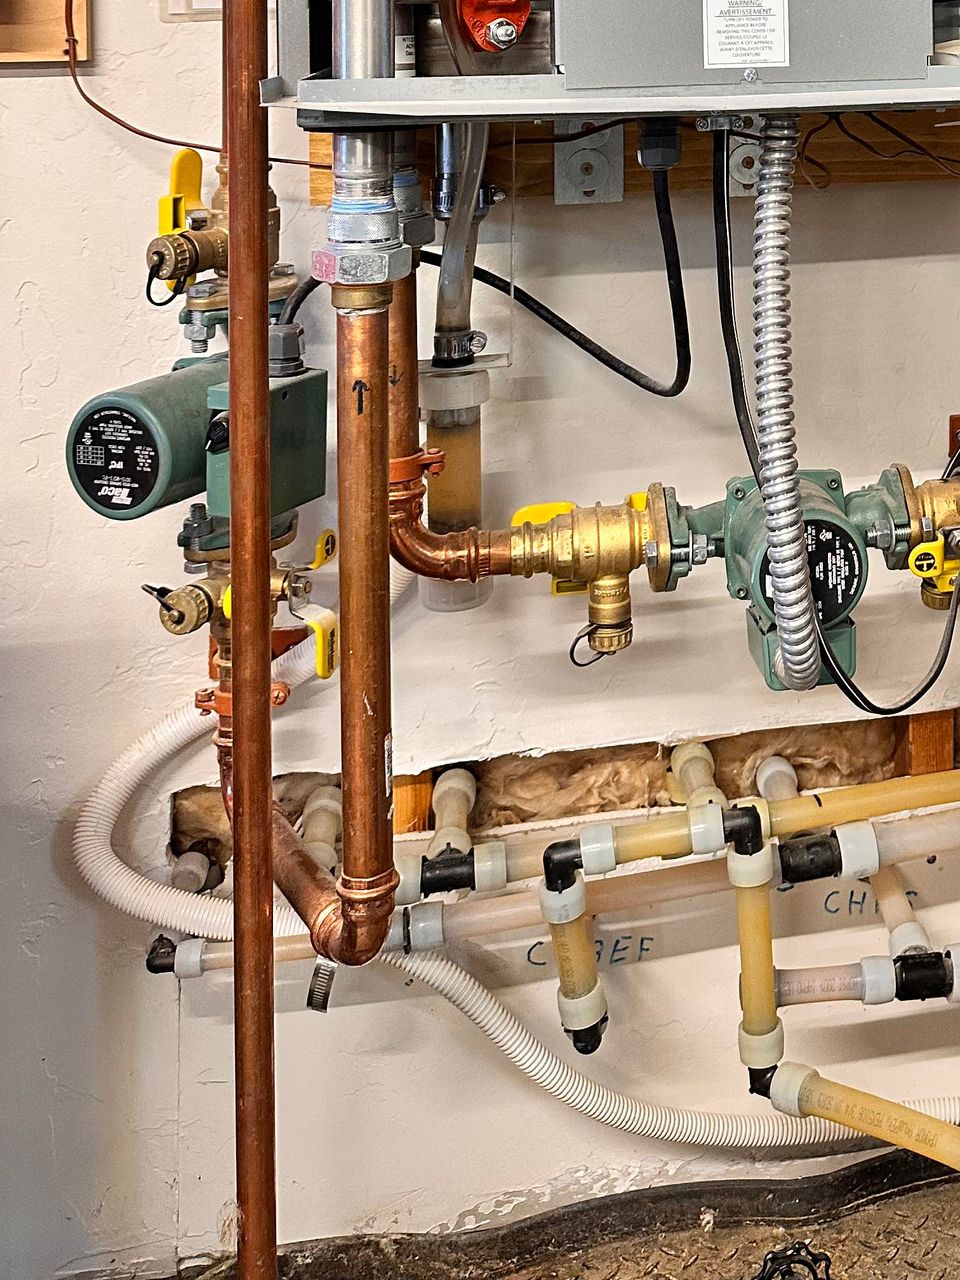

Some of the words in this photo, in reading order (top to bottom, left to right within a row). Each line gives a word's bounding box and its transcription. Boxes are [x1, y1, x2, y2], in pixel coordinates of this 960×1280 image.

[727, 0, 763, 7] WARNING/
[719, 8, 772, 16] AVERTISSEMENT
[99, 485, 133, 505] Taco
